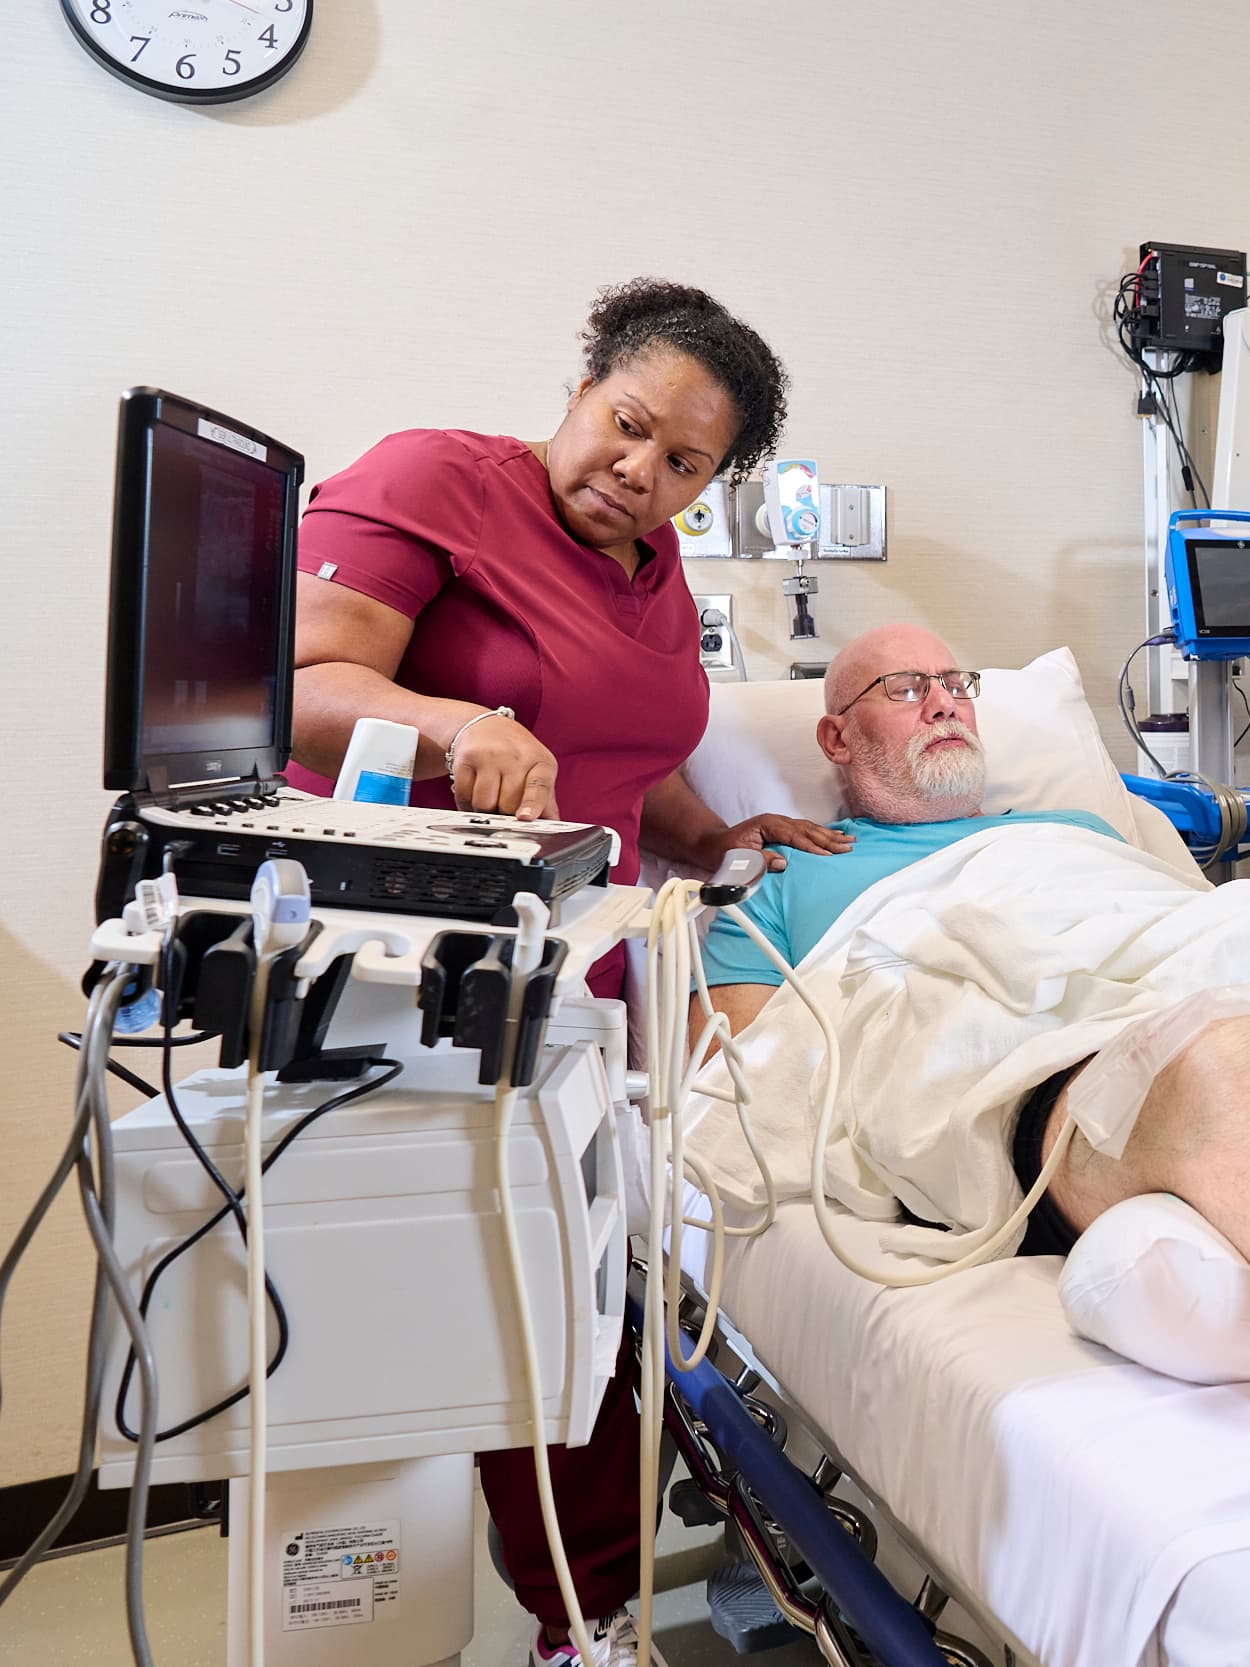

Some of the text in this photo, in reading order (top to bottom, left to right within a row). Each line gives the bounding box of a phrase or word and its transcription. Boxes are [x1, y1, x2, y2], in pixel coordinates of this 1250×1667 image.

[90, 0, 112, 24] 8
[129, 35, 151, 62] 7
[258, 24, 279, 49] 4
[175, 54, 197, 79] 6
[222, 49, 241, 75] 5
